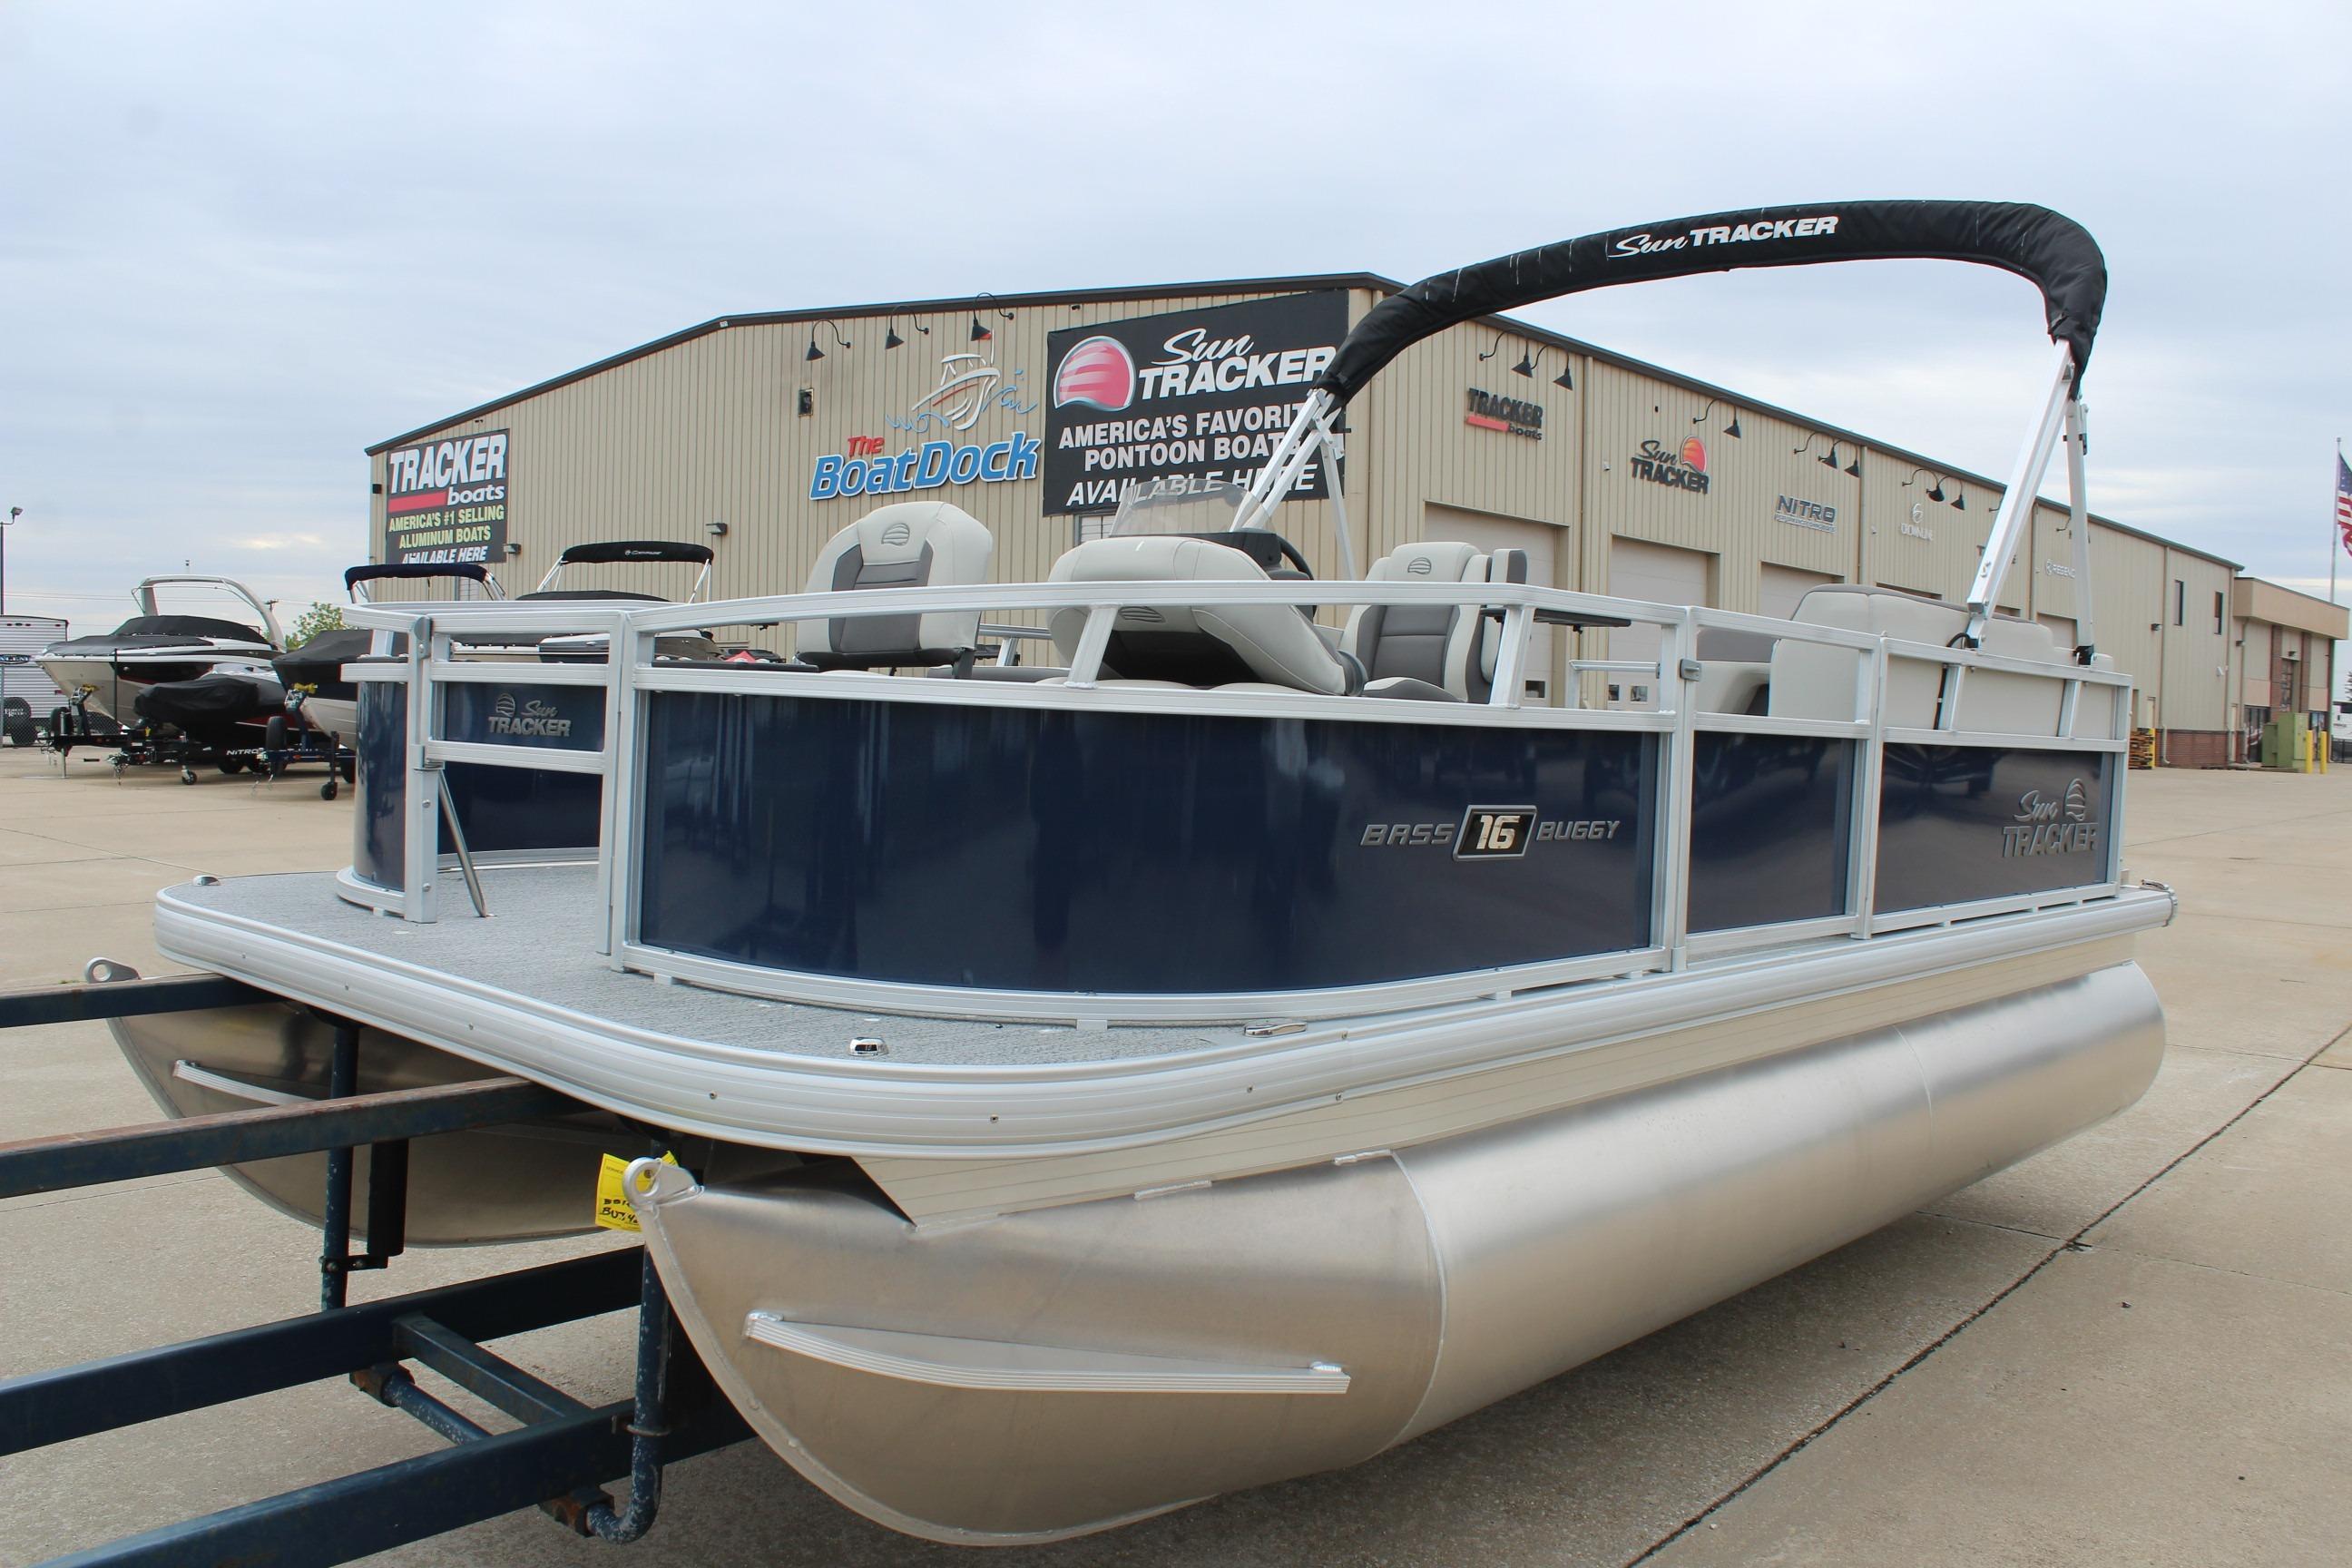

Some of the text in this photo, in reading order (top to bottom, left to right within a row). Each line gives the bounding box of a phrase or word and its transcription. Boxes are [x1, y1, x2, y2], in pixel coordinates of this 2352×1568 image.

[1607, 216, 1839, 259] Sun TRACKER
[1152, 328, 1254, 366] Sun
[1138, 346, 1337, 400] TRACKER
[1466, 387, 1544, 428] TRACKER
[1058, 402, 1308, 449] AMERICA'S FAVORIT
[1507, 423, 1543, 441] boats
[848, 436, 885, 457] The
[1083, 438, 1206, 472] PONTOON
[1637, 439, 1678, 465] Sun
[389, 434, 507, 494] TRACKER
[1631, 457, 1710, 495] TRACKER
[446, 485, 505, 506] boats
[1065, 470, 1224, 507] AVAILABLE
[388, 505, 505, 533] AMERICA'S #1 SELLING
[1776, 494, 1837, 524] NITRO
[398, 524, 492, 549] ALUMINUM BOATS
[457, 545, 488, 563] HERE
[521, 700, 558, 718] Sun
[488, 716, 572, 737] TRACKER
[2014, 789, 2058, 822] Sun
[1360, 814, 1621, 850] BASS 16 BUGGY
[2002, 822, 2099, 858] TRACKER
